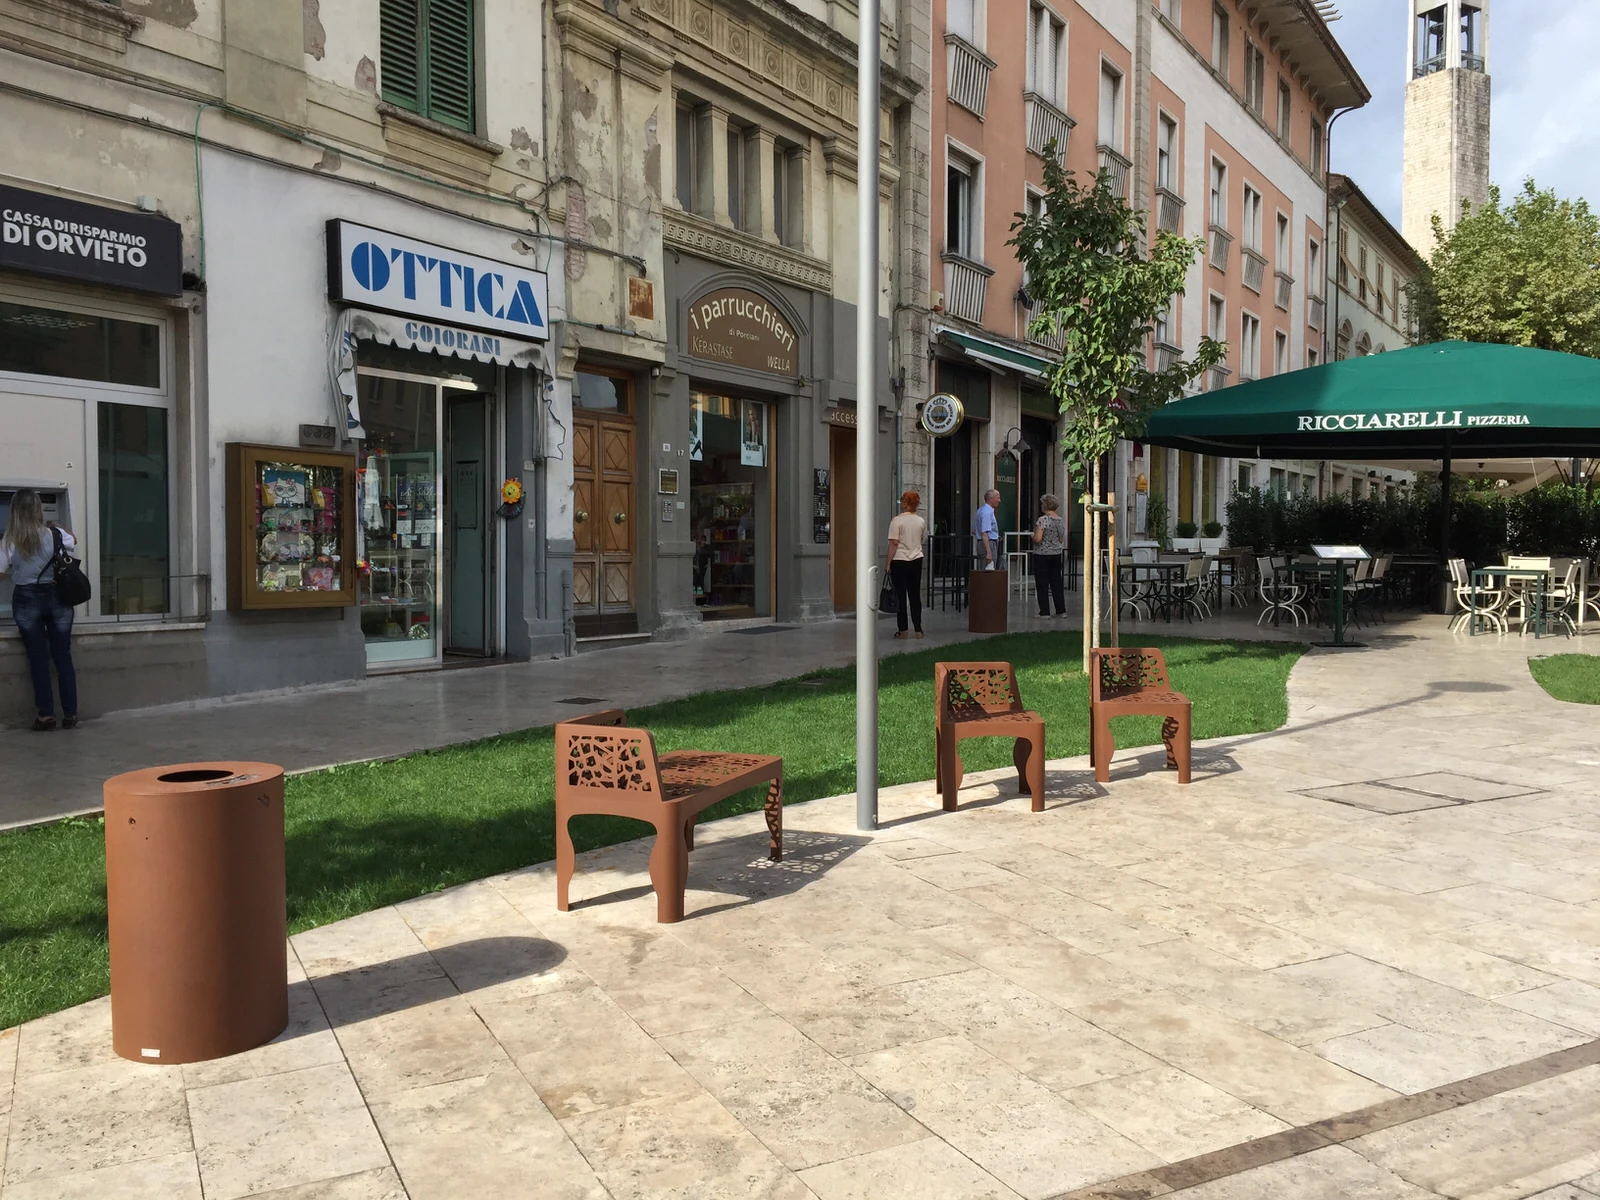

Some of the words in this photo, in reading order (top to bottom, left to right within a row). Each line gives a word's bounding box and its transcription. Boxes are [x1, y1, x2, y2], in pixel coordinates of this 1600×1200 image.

[3, 208, 53, 229] CASSA
[54, 219, 69, 232] DI
[70, 222, 147, 248] RISPARMIO
[3, 221, 30, 246] DI
[36, 229, 147, 268] ORVIETO
[351, 241, 544, 328] OTTICA
[405, 321, 500, 356] GOIORANI
[690, 307, 700, 330] i
[701, 298, 795, 352] parrucchieri
[728, 328, 735, 336] di
[767, 354, 790, 371] WELLA
[1297, 411, 1463, 431] RICCIARELLI
[1467, 415, 1530, 426] PIZZERIA
